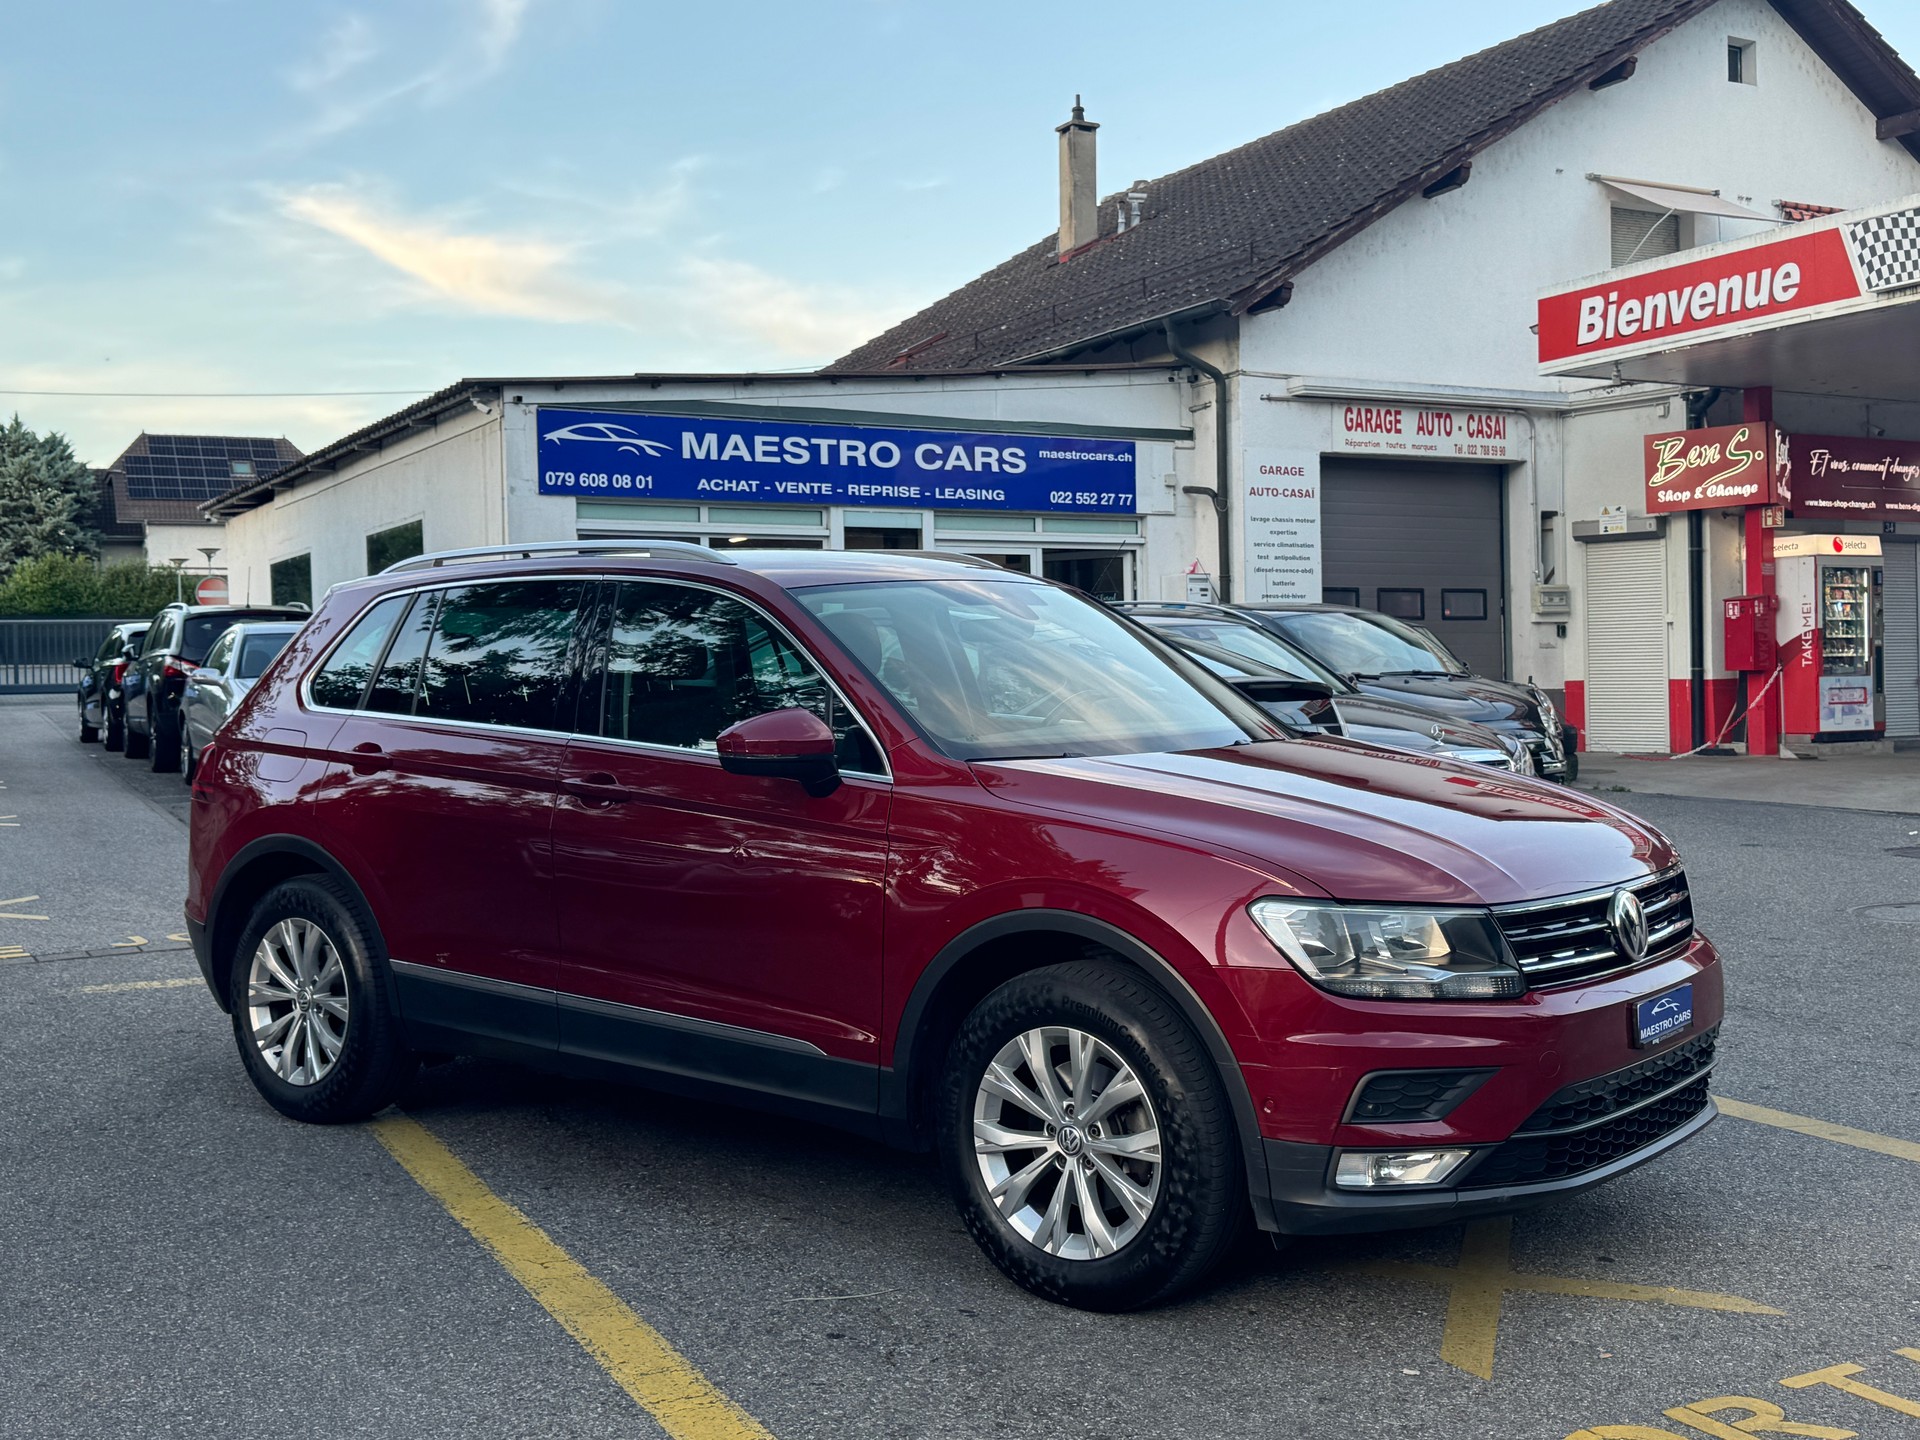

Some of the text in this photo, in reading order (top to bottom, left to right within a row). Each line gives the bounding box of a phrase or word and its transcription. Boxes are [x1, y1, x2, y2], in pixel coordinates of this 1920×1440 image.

[1576, 262, 1801, 346] Bienvenue
[1344, 406, 1402, 434] GARAGE
[1416, 411, 1453, 437] AUTO
[1466, 413, 1506, 440] CASAI
[681, 431, 1027, 474] MAESTRO CARS
[1345, 438, 1380, 449] Réparation
[1411, 443, 1437, 452] marques
[1467, 444, 1477, 455] 022
[1039, 449, 1132, 462] maestrocars.ch
[1649, 436, 1721, 487] Ben
[1810, 449, 1832, 477] Et
[1852, 457, 1892, 480] comment
[545, 471, 653, 489] 079 608 08 01
[1260, 465, 1305, 477] GARAGE
[697, 478, 760, 492] ACHAT
[774, 481, 833, 494] VENTE
[848, 484, 920, 498] REPRISE
[935, 487, 1005, 501] LEASING
[1050, 491, 1133, 506] 022 552 27 77
[1657, 483, 1758, 503] Shop & Change
[1805, 499, 1876, 510] www.bens-shop-change.ch
[1845, 541, 1867, 549] selecta
[1802, 602, 1813, 667] TAKE ME!
[1640, 1017, 1673, 1040] MAESTRO
[1673, 1009, 1692, 1025] CARS
